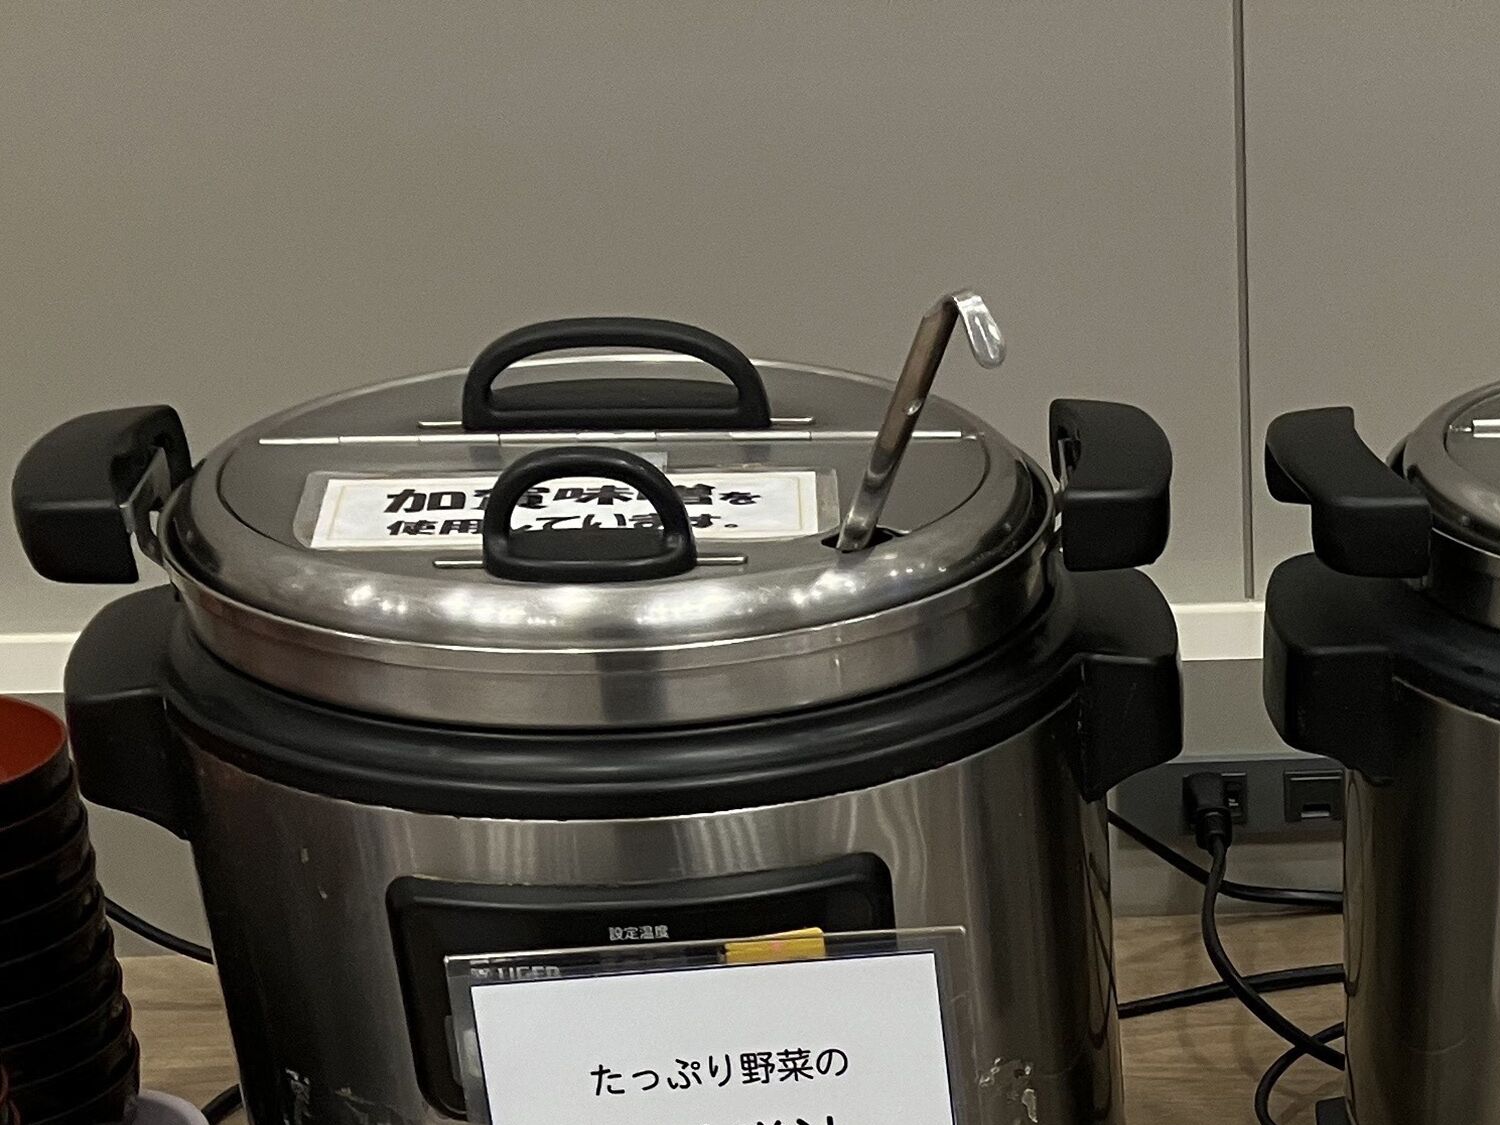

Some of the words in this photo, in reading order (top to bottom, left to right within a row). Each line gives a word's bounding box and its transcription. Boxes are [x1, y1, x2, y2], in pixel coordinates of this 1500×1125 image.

[609, 925, 670, 941] 設定温度
[590, 1048, 848, 1096] たっぷり野菜の
